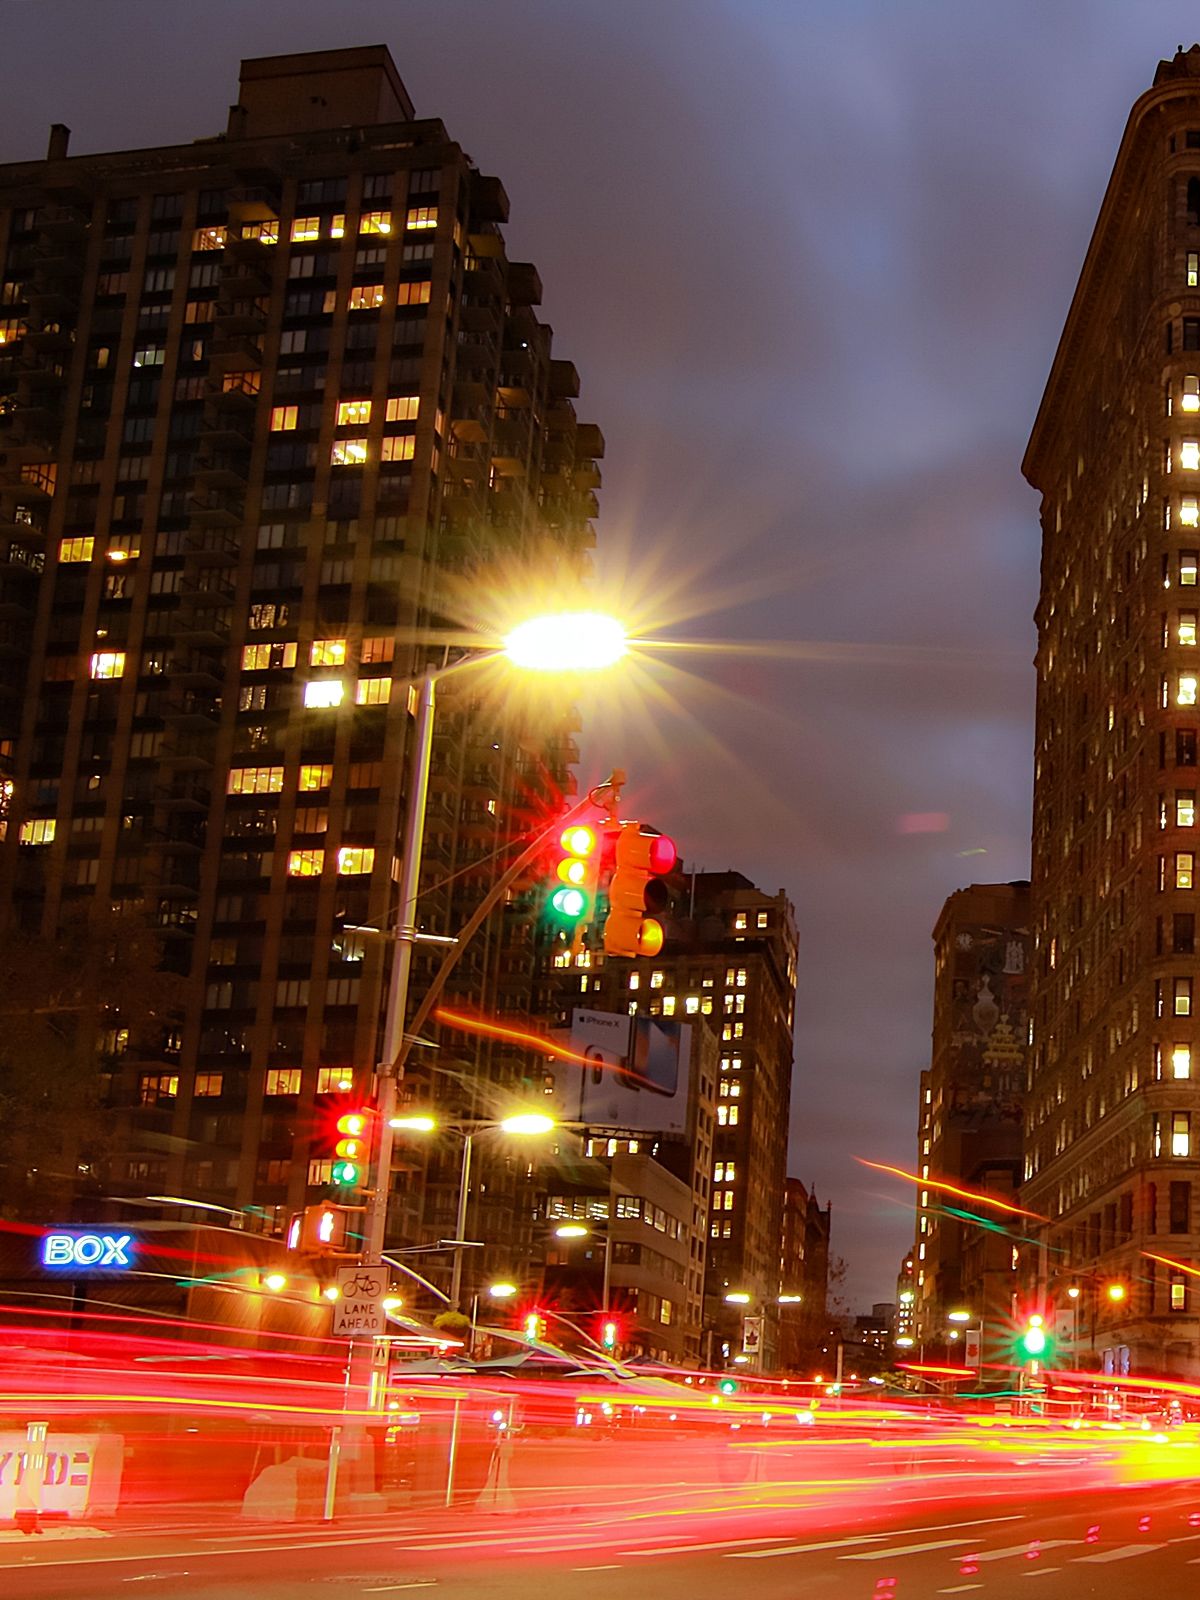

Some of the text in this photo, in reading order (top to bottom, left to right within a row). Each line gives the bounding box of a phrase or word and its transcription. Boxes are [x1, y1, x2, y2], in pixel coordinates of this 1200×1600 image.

[586, 1016, 612, 1027] iPhone
[43, 1235, 131, 1265] BOX
[344, 1303, 375, 1315] LANE
[338, 1318, 378, 1329] AHEAD
